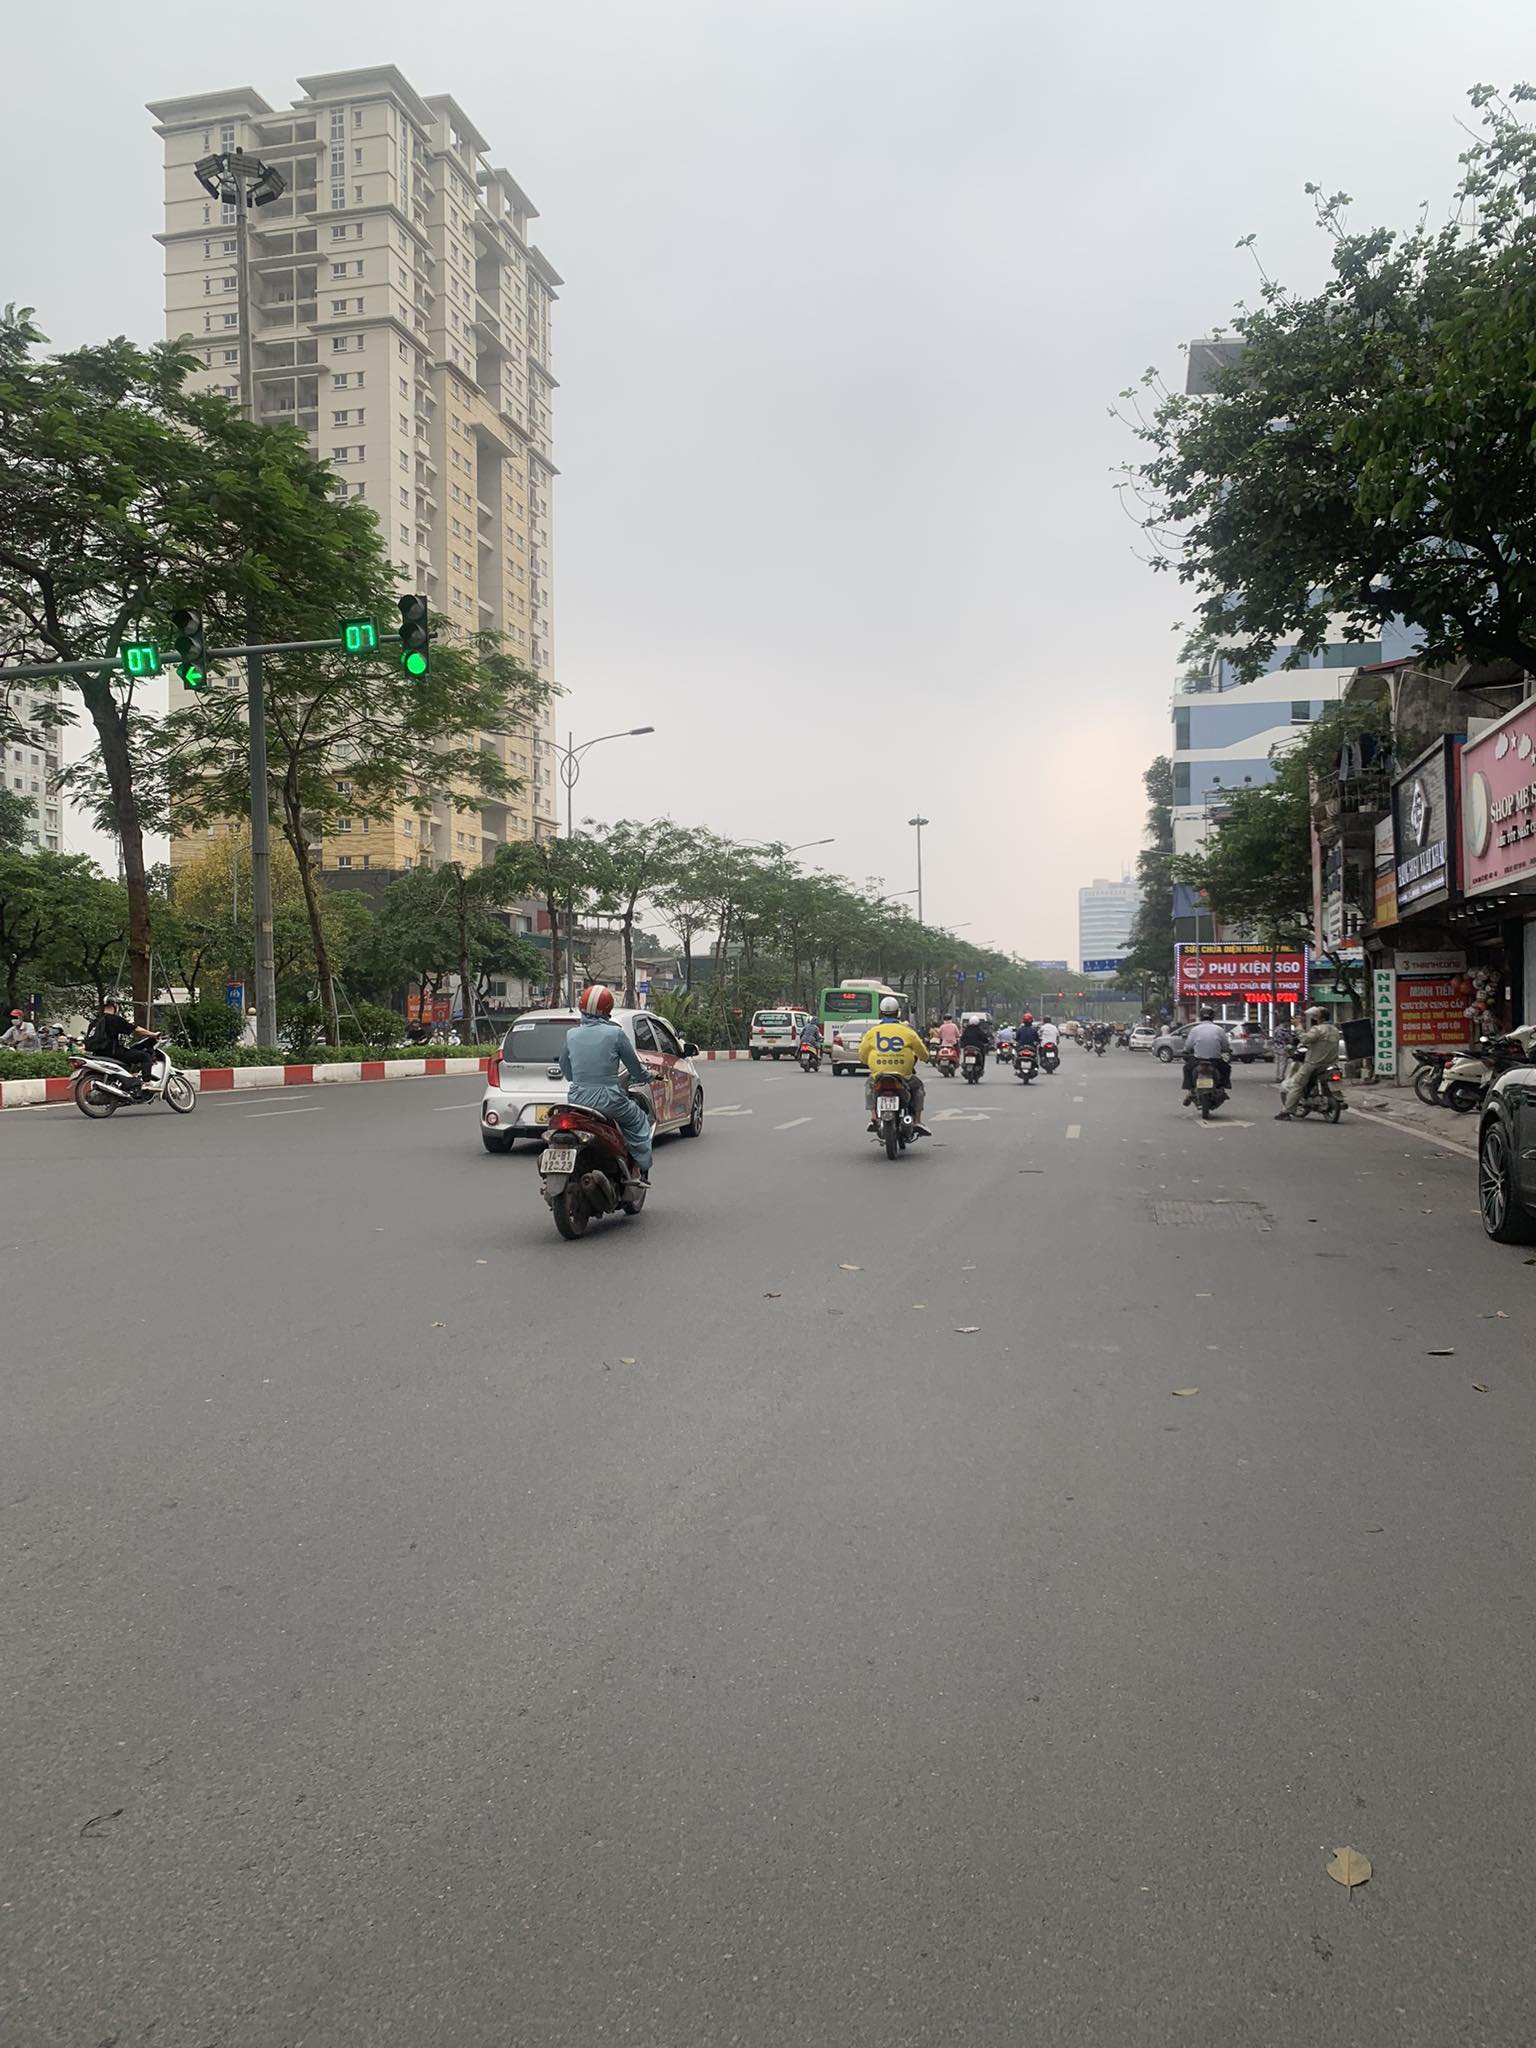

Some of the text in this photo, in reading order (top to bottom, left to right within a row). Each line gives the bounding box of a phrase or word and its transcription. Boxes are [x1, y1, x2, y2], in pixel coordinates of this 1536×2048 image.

[346, 625, 375, 650] 07
[127, 648, 156, 672] 07
[1490, 794, 1514, 824] SHOP
[1208, 963, 1237, 976] PHỤ
[1239, 960, 1271, 976] KIỆN
[1274, 962, 1300, 973] 360
[876, 1032, 904, 1052] be
[1378, 1063, 1393, 1072] 48
